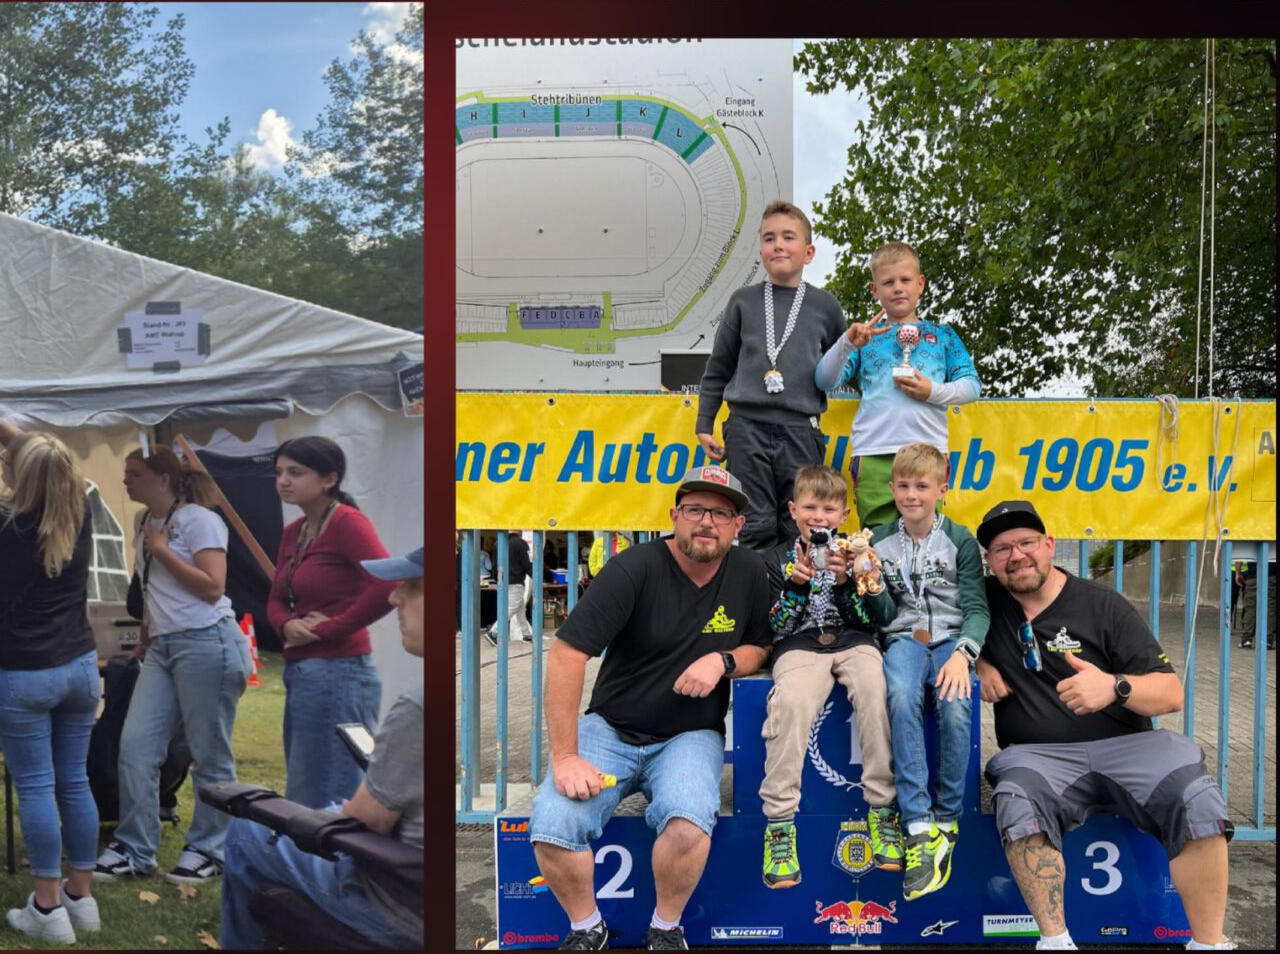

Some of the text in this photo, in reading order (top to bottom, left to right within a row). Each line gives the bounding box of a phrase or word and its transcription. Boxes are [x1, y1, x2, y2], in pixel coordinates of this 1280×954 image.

[531, 94, 602, 105] Stehtribünen
[725, 97, 755, 107] Eingang
[758, 109, 765, 117] K
[639, 106, 646, 116] K
[676, 127, 682, 138] L
[572, 358, 625, 369] Haupteingang
[1019, 437, 1150, 493] 1905
[595, 844, 635, 899] 2
[1081, 840, 1123, 896] 3
[728, 928, 780, 937] MICHELIN
[829, 921, 882, 935] Red Bull
